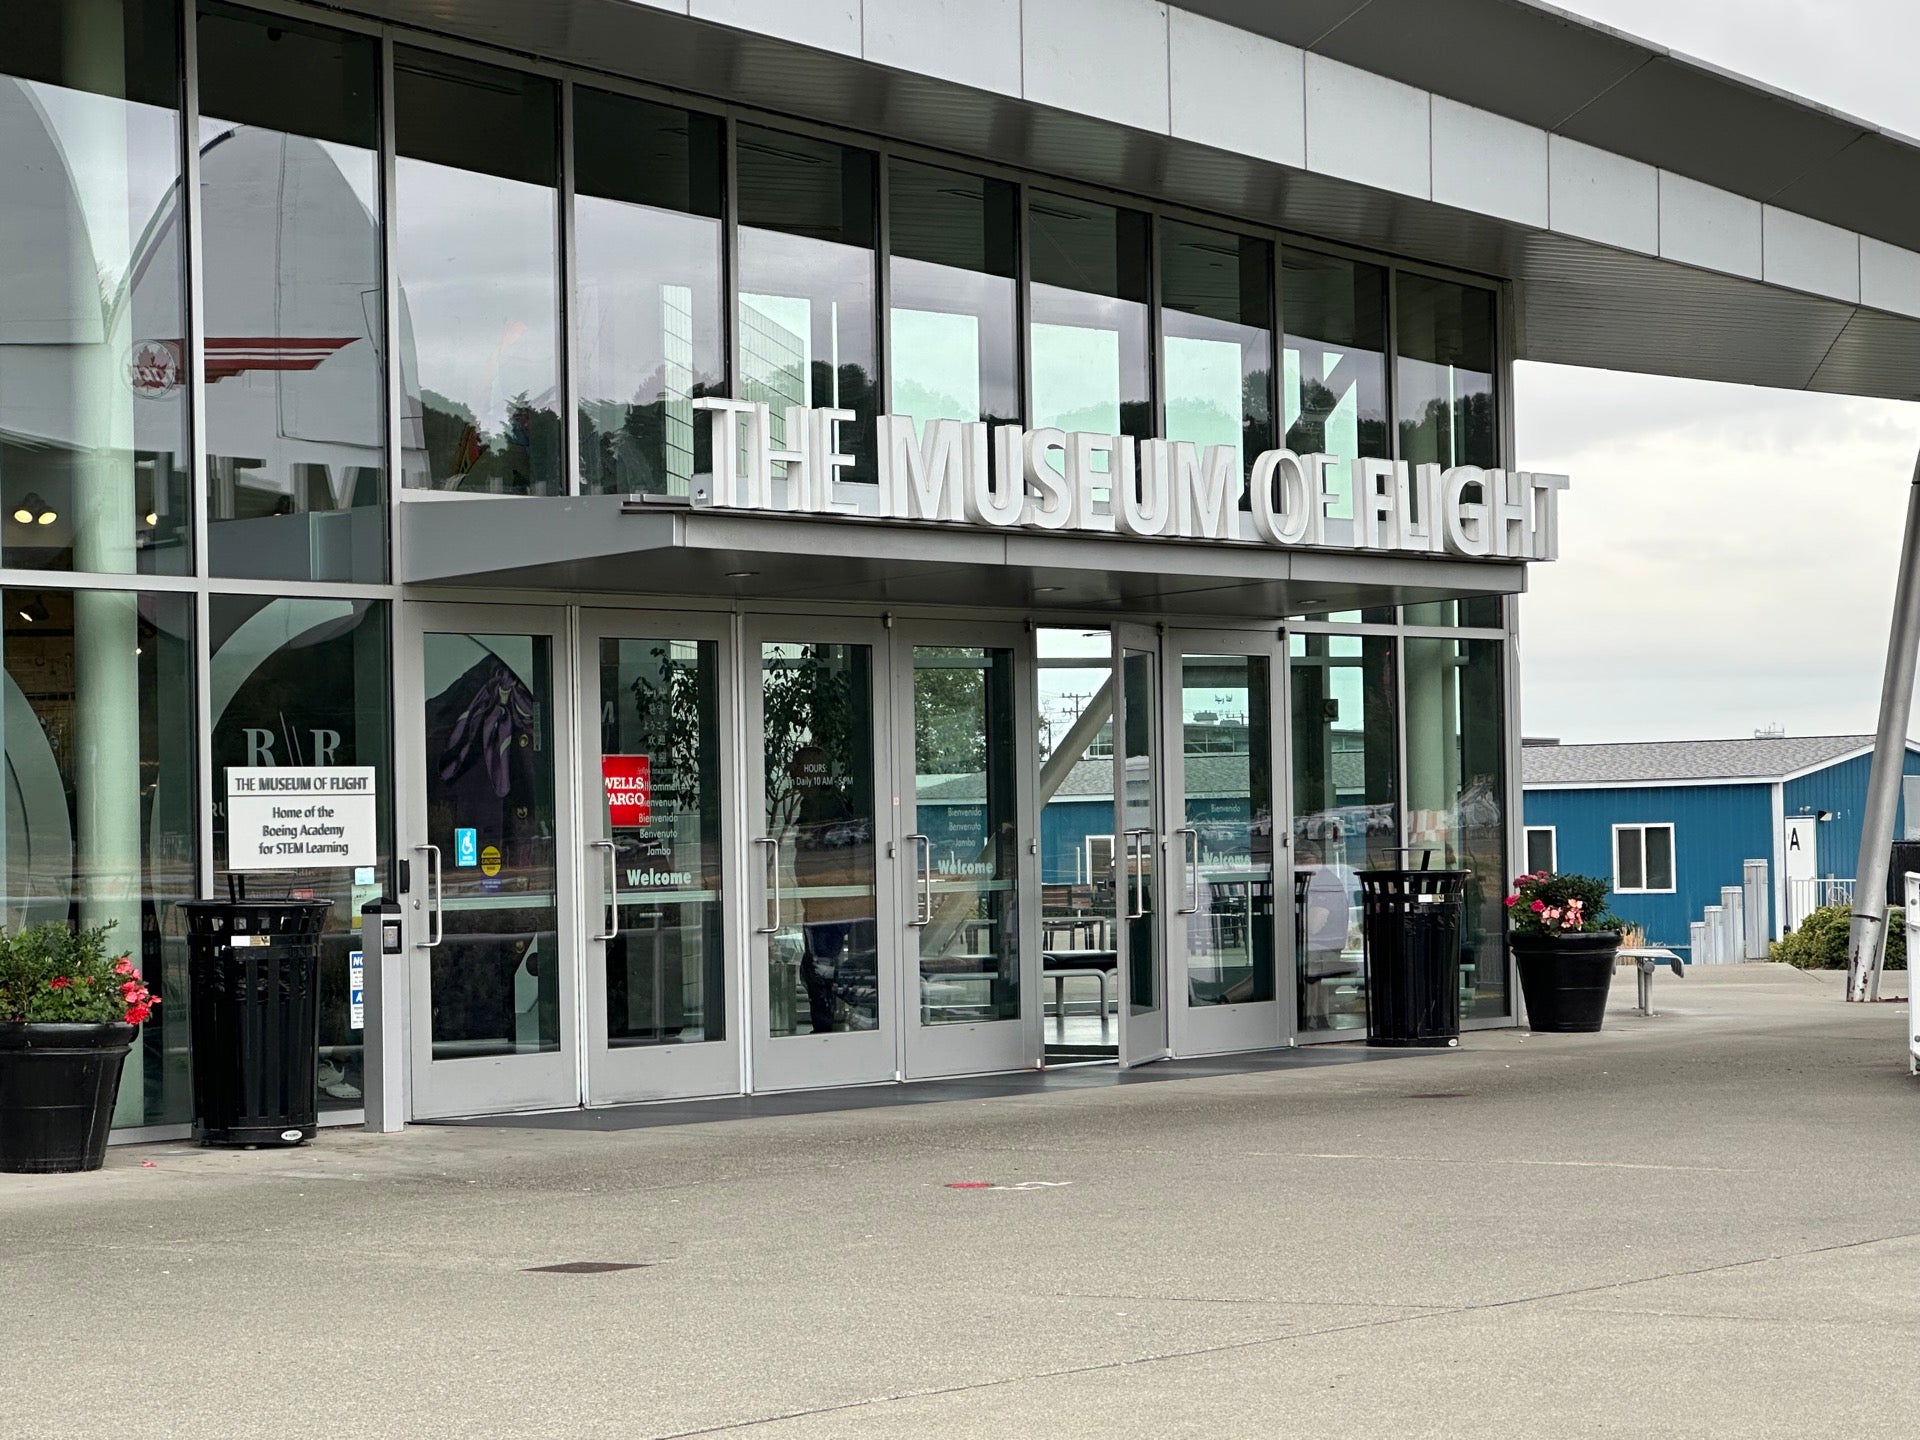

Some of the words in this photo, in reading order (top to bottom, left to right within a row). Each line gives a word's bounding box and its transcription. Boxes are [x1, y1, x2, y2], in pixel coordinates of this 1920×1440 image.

[692, 396, 859, 515] THE
[876, 413, 1240, 540] MUSEUM
[1251, 447, 1340, 545] OF
[1352, 456, 1571, 560] FLIGHT
[234, 777, 256, 791] THE
[258, 777, 312, 791] MUSEUM
[313, 776, 328, 790] OF
[329, 776, 369, 790] FLIGHT
[821, 776, 834, 785] AM
[606, 792, 645, 806] ARGO
[272, 806, 302, 819] Home
[304, 805, 316, 818] of
[317, 805, 335, 818] the
[638, 812, 679, 823] Bienvenido
[948, 807, 983, 817] Bienvenido
[262, 824, 298, 840] Boeing
[299, 823, 345, 838] Academy
[639, 828, 678, 839] Benvenuto
[1789, 827, 1801, 851] A
[258, 842, 274, 855] for
[276, 842, 304, 855] STEM
[306, 841, 349, 856] Learning
[646, 845, 672, 857] Jambo
[938, 858, 994, 875] Welcome
[626, 867, 692, 886] Welcome
